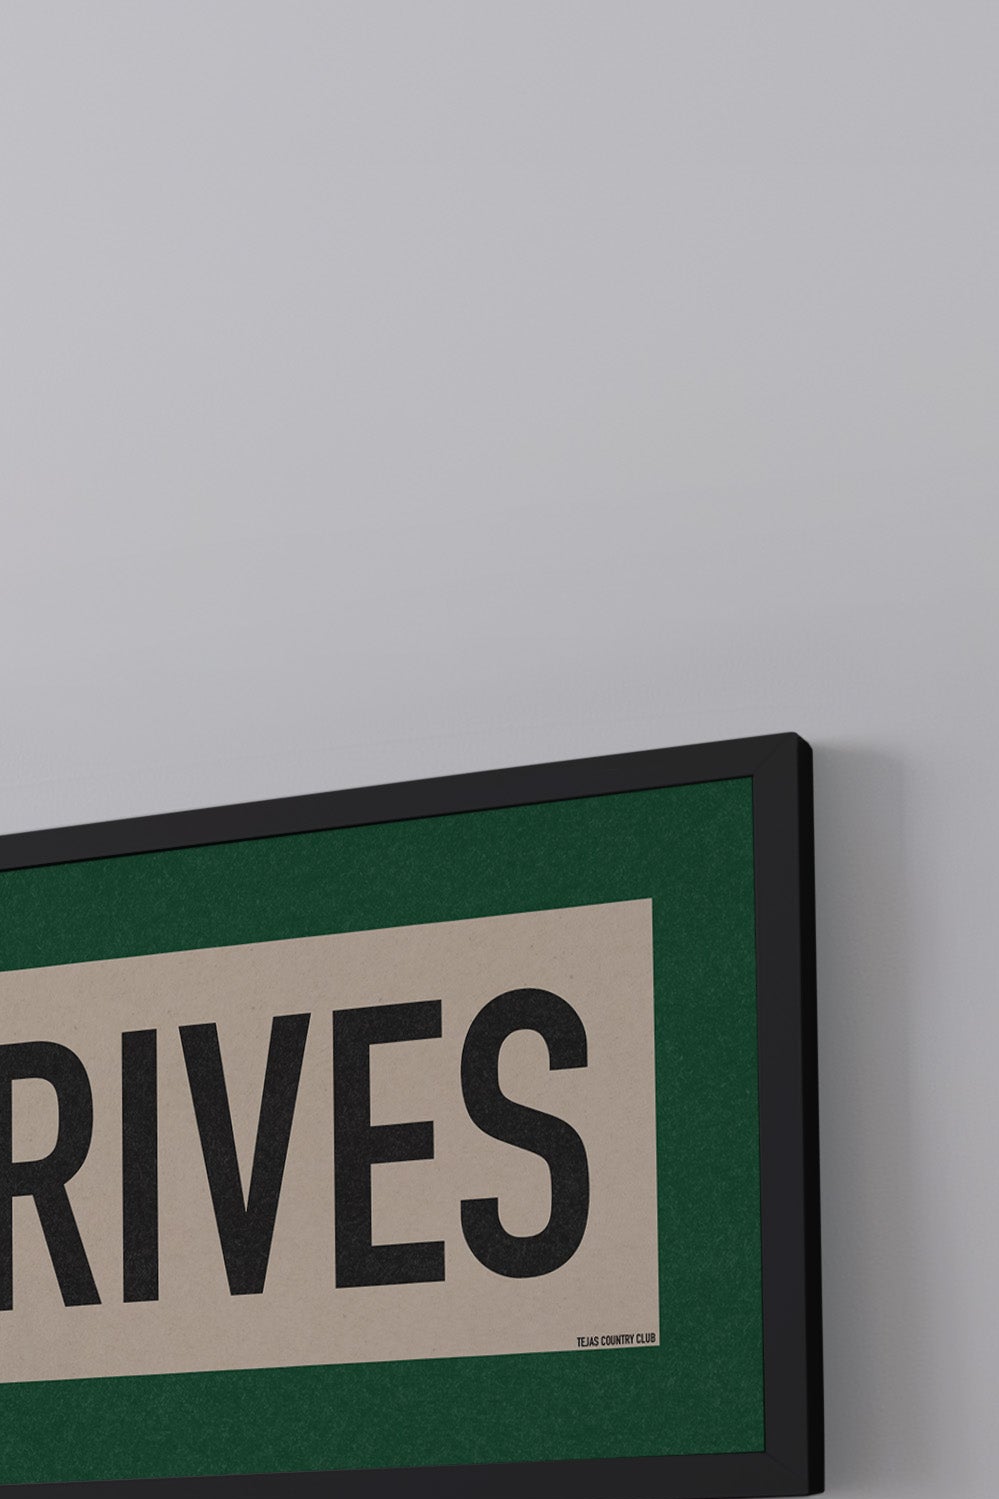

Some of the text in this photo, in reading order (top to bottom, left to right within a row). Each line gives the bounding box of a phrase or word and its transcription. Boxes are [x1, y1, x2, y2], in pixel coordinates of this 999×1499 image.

[577, 1332, 656, 1347] TEJAS COUNTRY CLUB
